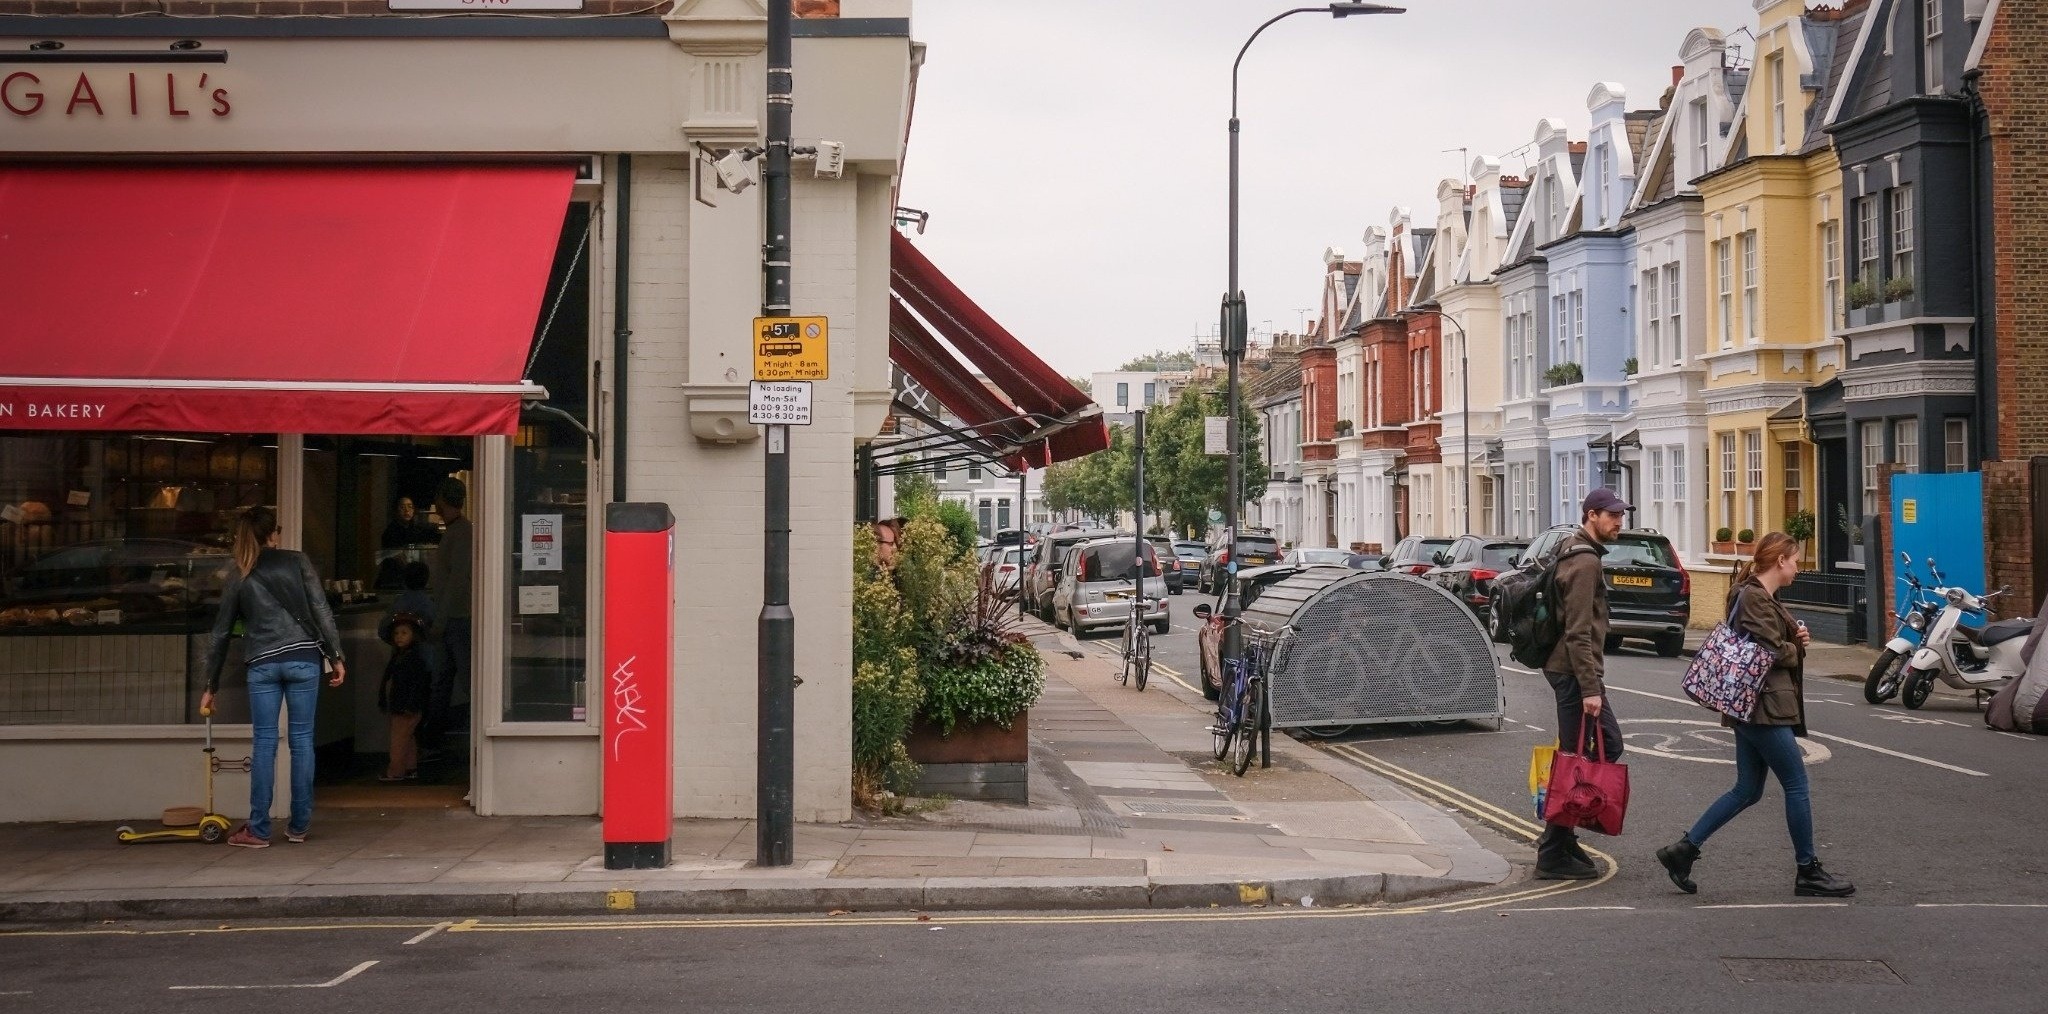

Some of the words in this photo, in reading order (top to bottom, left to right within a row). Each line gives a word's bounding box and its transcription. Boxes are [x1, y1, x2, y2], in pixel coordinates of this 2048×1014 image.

[1, 71, 231, 116] GAIL's
[774, 324, 790, 335] 5T
[773, 385, 802, 393] loading
[28, 404, 105, 418] BAKERY
